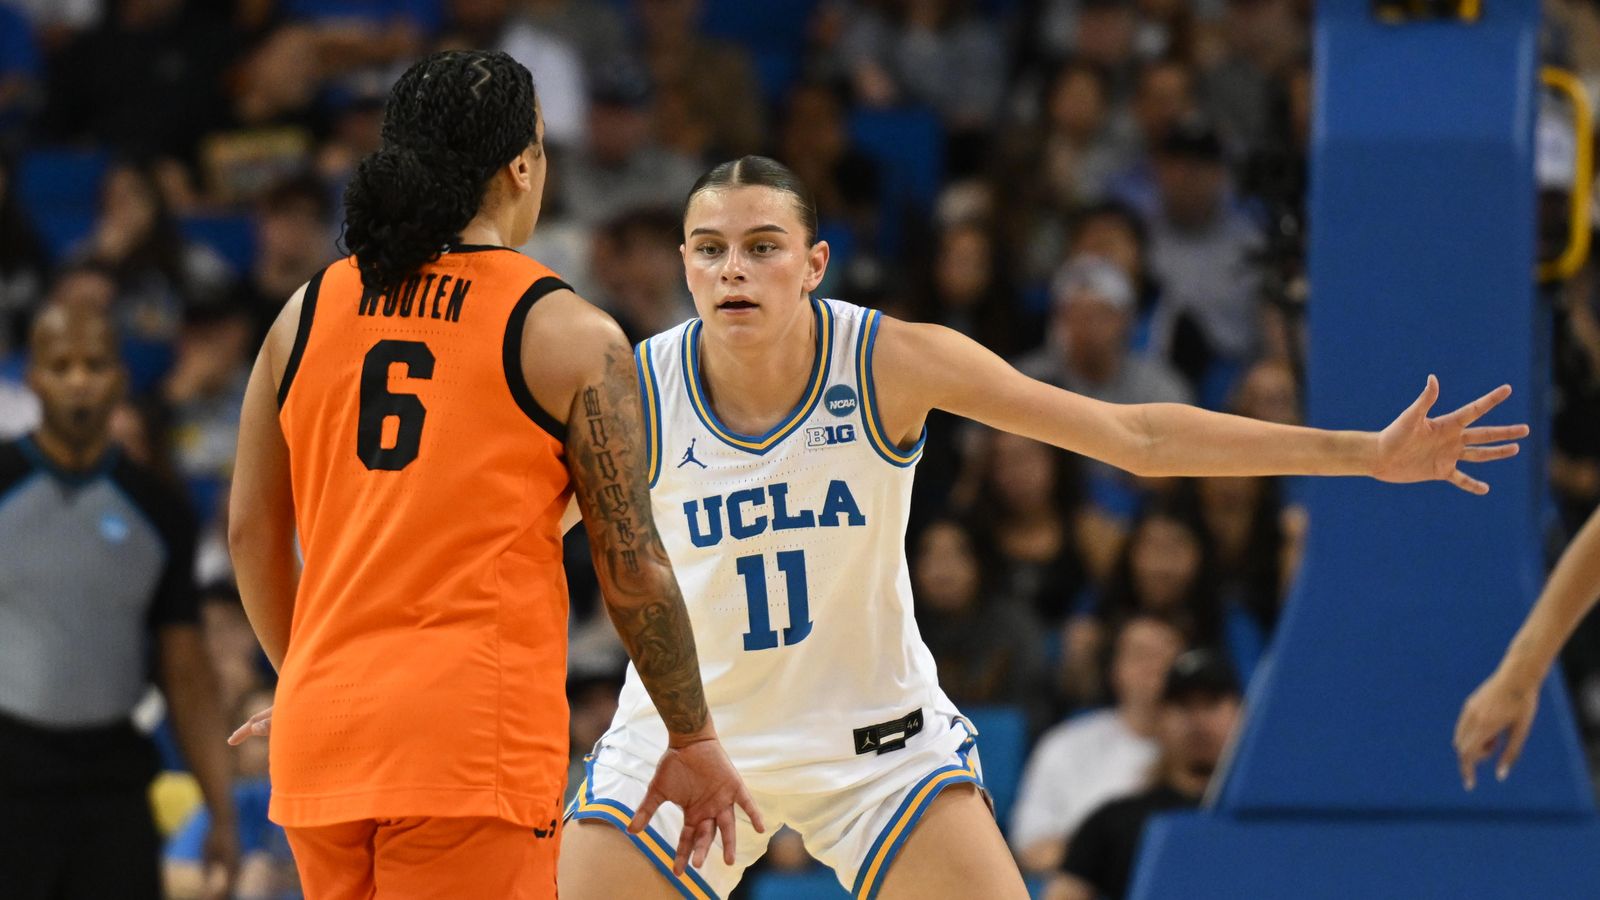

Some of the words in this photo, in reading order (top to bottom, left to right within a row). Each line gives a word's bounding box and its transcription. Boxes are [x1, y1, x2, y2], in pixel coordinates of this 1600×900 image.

[357, 339, 436, 471] 6
[829, 398, 856, 410] NCAA
[683, 479, 866, 548] UCLA
[736, 549, 814, 651] 11
[906, 718, 920, 730] 44
